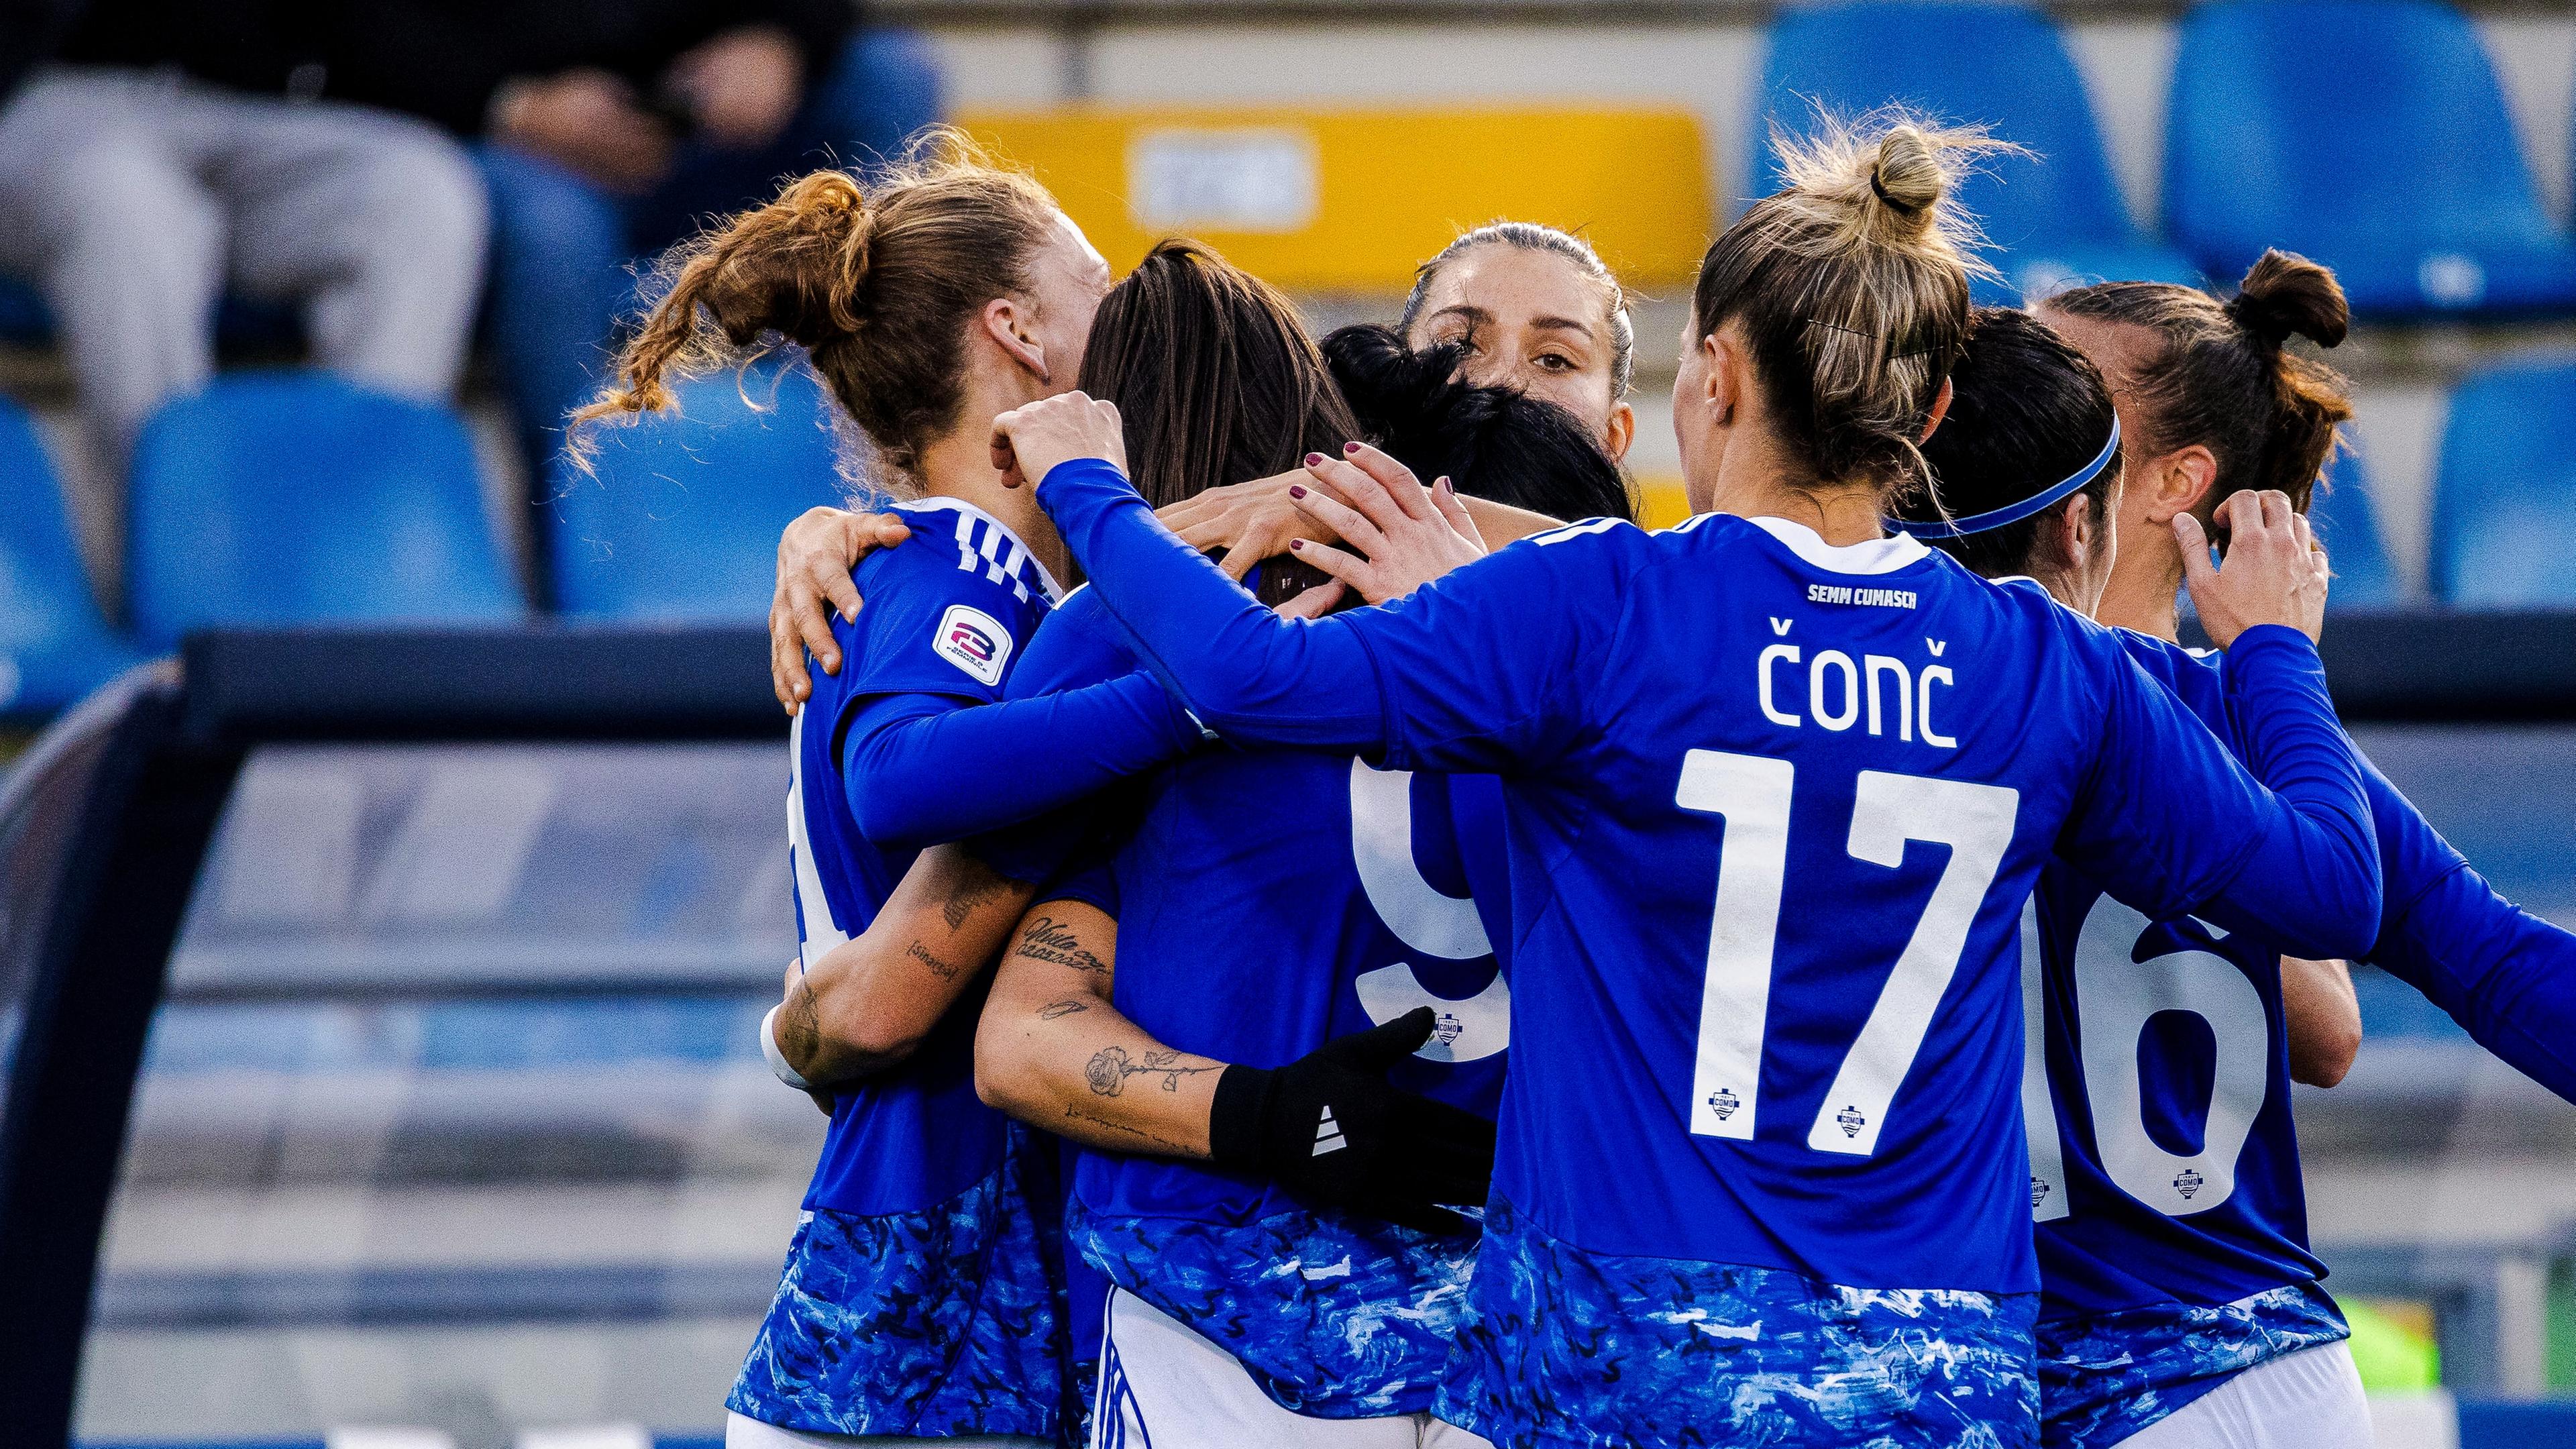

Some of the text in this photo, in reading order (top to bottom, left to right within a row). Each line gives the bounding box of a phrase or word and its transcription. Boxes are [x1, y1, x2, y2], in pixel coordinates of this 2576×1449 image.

[1808, 584, 1917, 609] SEMM CUMASCH
[1676, 748, 2019, 1157] 17
[1439, 1024, 1456, 1032] COMO
[1715, 1098, 1733, 1108] COMO
[2180, 1178, 2197, 1187] COMO
